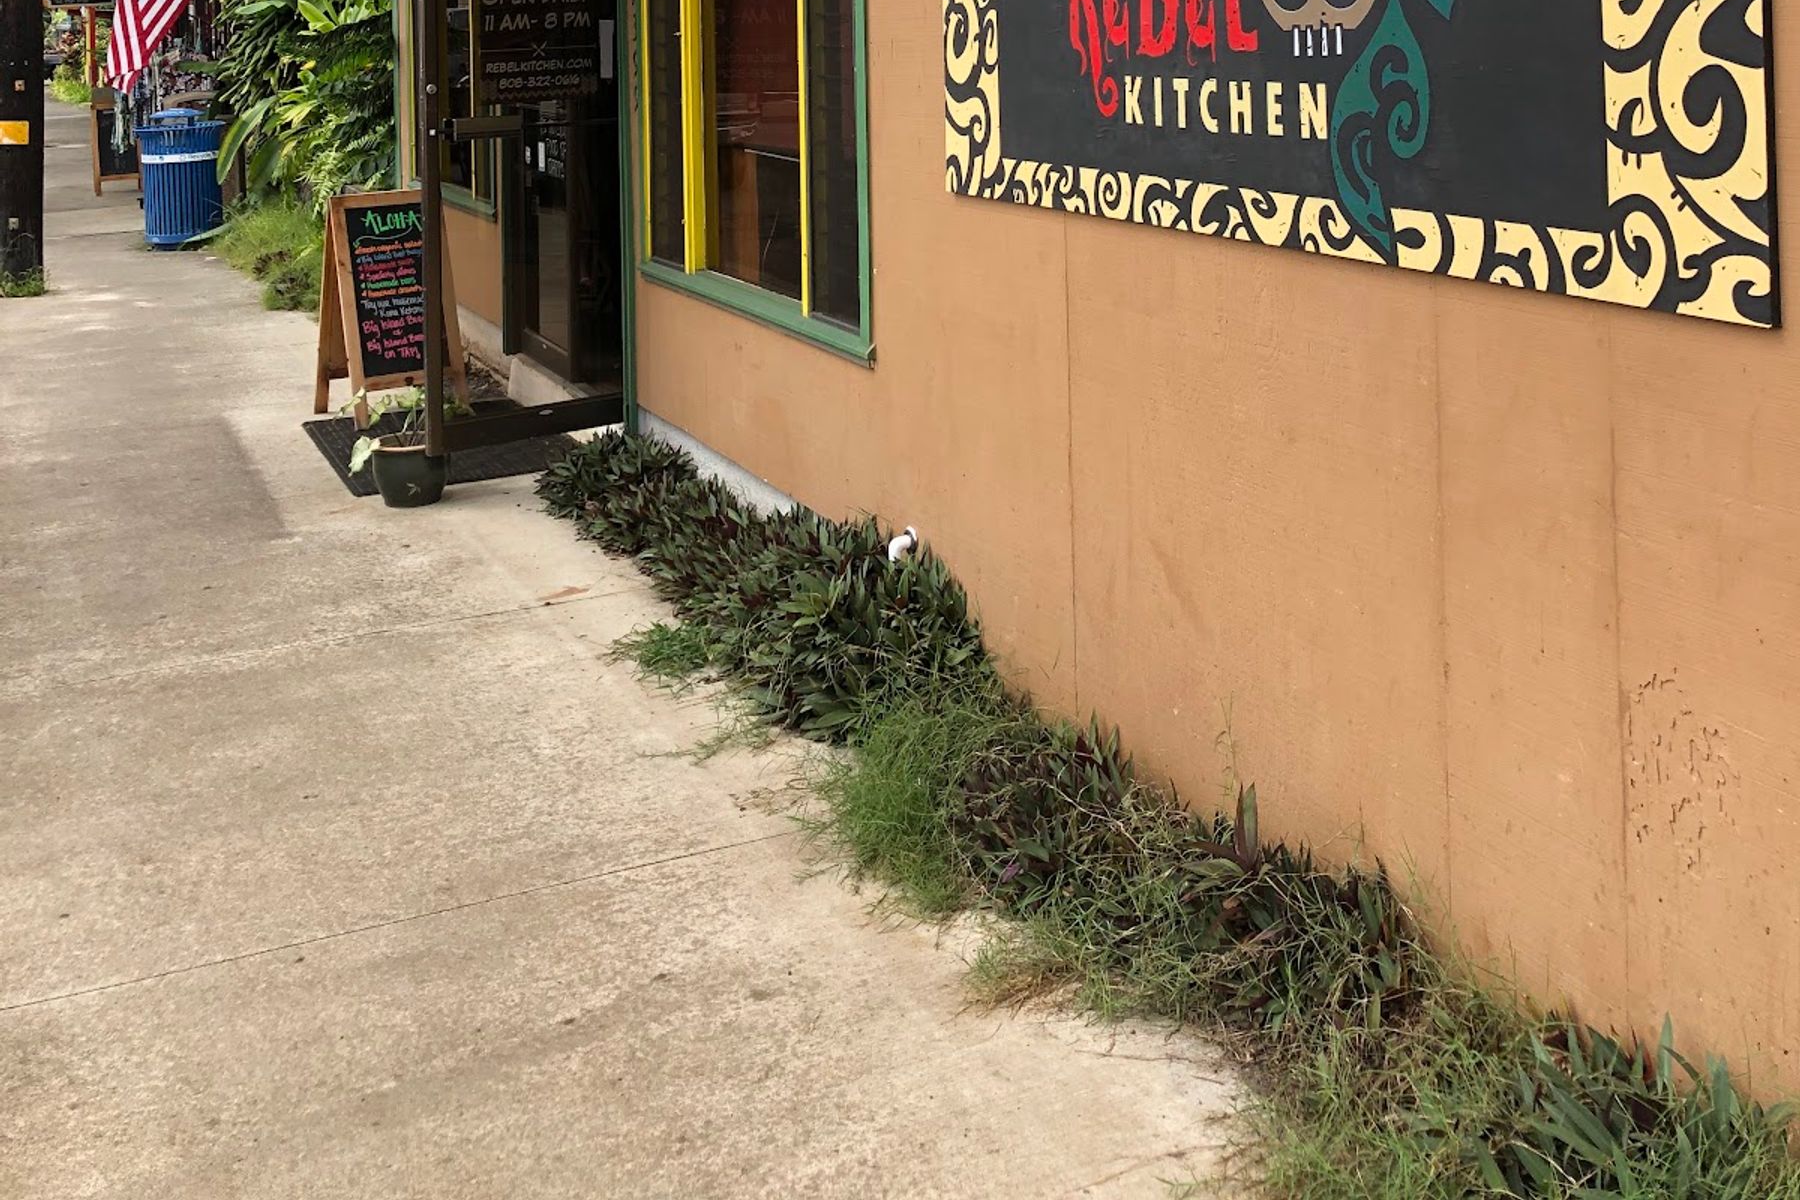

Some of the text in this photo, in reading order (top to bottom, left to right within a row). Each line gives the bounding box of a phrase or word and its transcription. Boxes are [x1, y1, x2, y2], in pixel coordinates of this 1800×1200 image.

[544, 12, 558, 29] 8
[562, 11, 592, 28] PM
[485, 58, 593, 74] REBELKITCHEN.COM
[1124, 75, 1329, 140] KITCHEN
[360, 210, 423, 234] ALOHA
